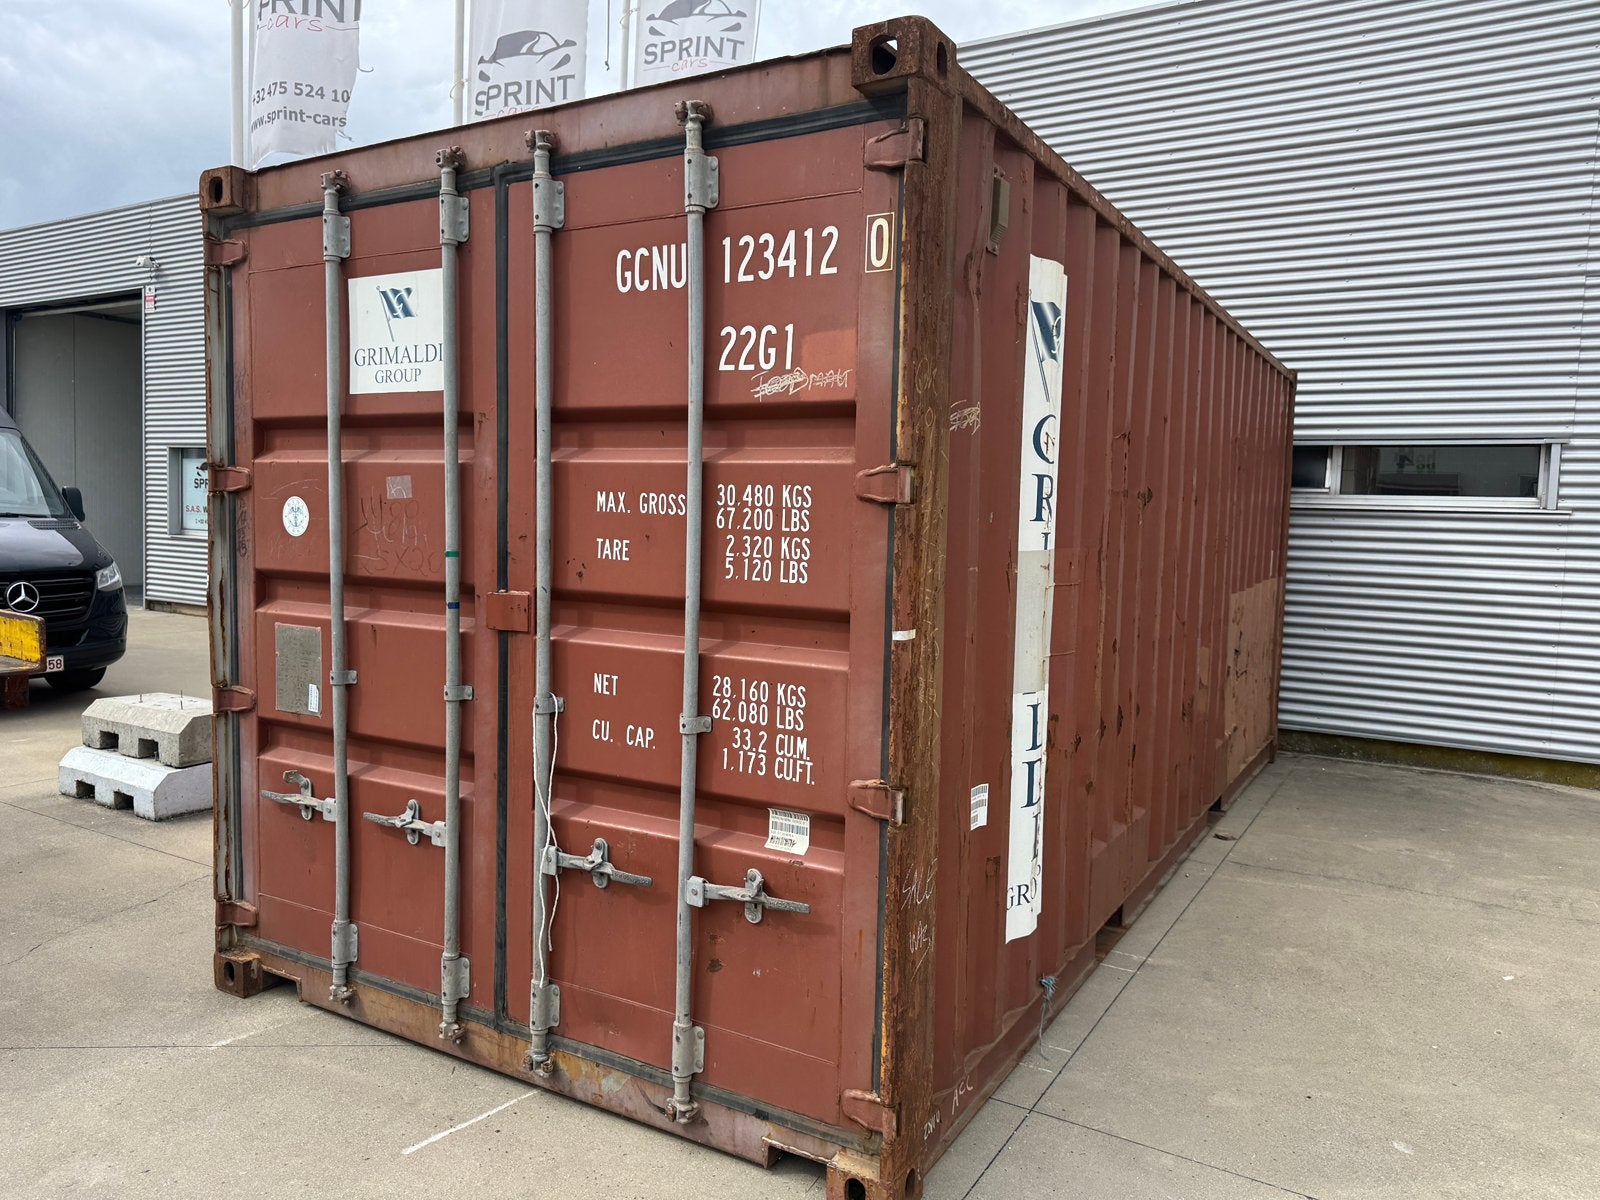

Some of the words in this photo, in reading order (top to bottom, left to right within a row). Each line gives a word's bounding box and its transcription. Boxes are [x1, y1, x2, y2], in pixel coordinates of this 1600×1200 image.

[644, 36, 745, 65] SPRINT
[267, 81, 288, 98] 475
[294, 82, 325, 100] 524
[474, 73, 576, 117] SPRINT
[616, 242, 688, 293] GCNU
[722, 225, 840, 284] 123412
[870, 217, 890, 269] 0
[354, 343, 444, 367] GRIMALDI
[718, 323, 795, 371] 22G1
[375, 368, 422, 384] GROUP
[596, 490, 631, 514] MAX.
[639, 492, 687, 516] GROSS
[716, 484, 774, 507] 30,480
[782, 484, 812, 508] KGS
[716, 507, 773, 531] 67,200
[781, 509, 810, 532] LBS
[596, 538, 630, 561] TARE
[725, 534, 772, 558] 2,320
[781, 536, 811, 560] KGS
[725, 557, 772, 581] 5,120
[780, 560, 808, 584] LBS
[593, 672, 619, 696] NET
[712, 675, 769, 703] 28,160
[777, 683, 806, 708] KGS
[712, 698, 768, 726] 62,080
[776, 706, 804, 731] LBS
[592, 719, 614, 743] CU.
[626, 724, 656, 750] CAP.
[732, 726, 768, 754] 33.2
[775, 733, 810, 761] CU.M.
[723, 747, 766, 776] 1,173
[774, 757, 815, 785] CU.FT.
